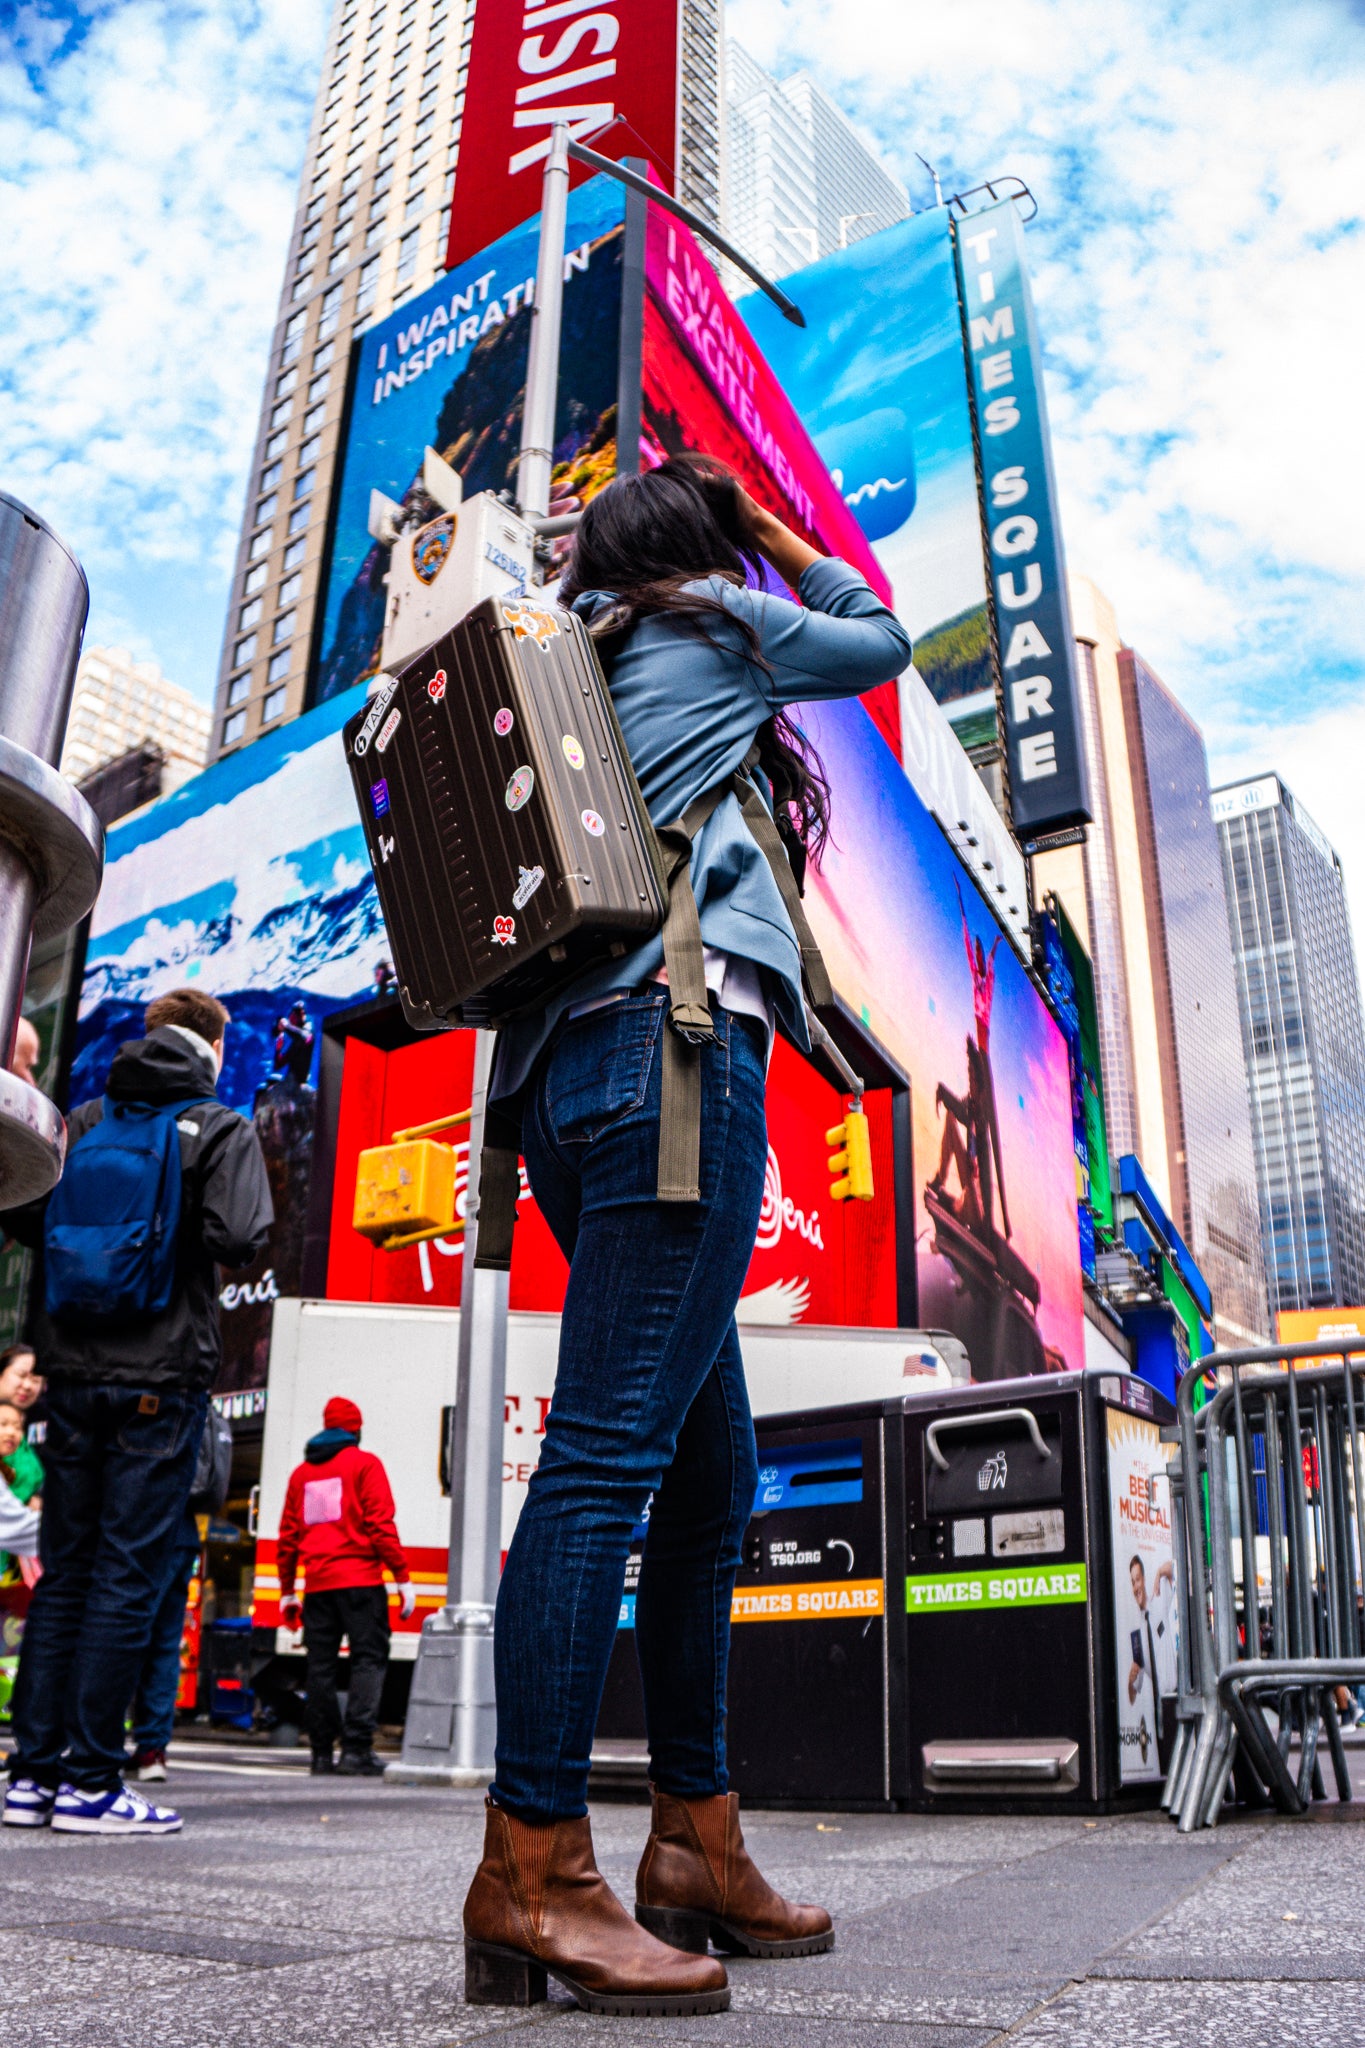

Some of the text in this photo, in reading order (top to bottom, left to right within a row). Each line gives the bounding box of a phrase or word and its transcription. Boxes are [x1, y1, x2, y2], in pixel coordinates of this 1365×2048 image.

[508, 0, 621, 176] VISI
[373, 242, 590, 405] INSPIRATIN
[377, 269, 497, 370] I WANT
[667, 224, 757, 393] I WANT
[966, 228, 1021, 436] TIMES
[665, 266, 815, 533] EXCITEMENT
[991, 465, 1058, 782] SQUARE
[518, 874, 540, 903] accelerate
[1119, 1495, 1171, 1530] MUSICAL
[1129, 1474, 1159, 1502] BEST
[770, 1541, 798, 1553] GO TO
[770, 1551, 822, 1567] TSQ.ORG
[732, 1589, 879, 1615] TIMES SQUARE
[911, 1574, 1081, 1605] TIMES SQUARE
